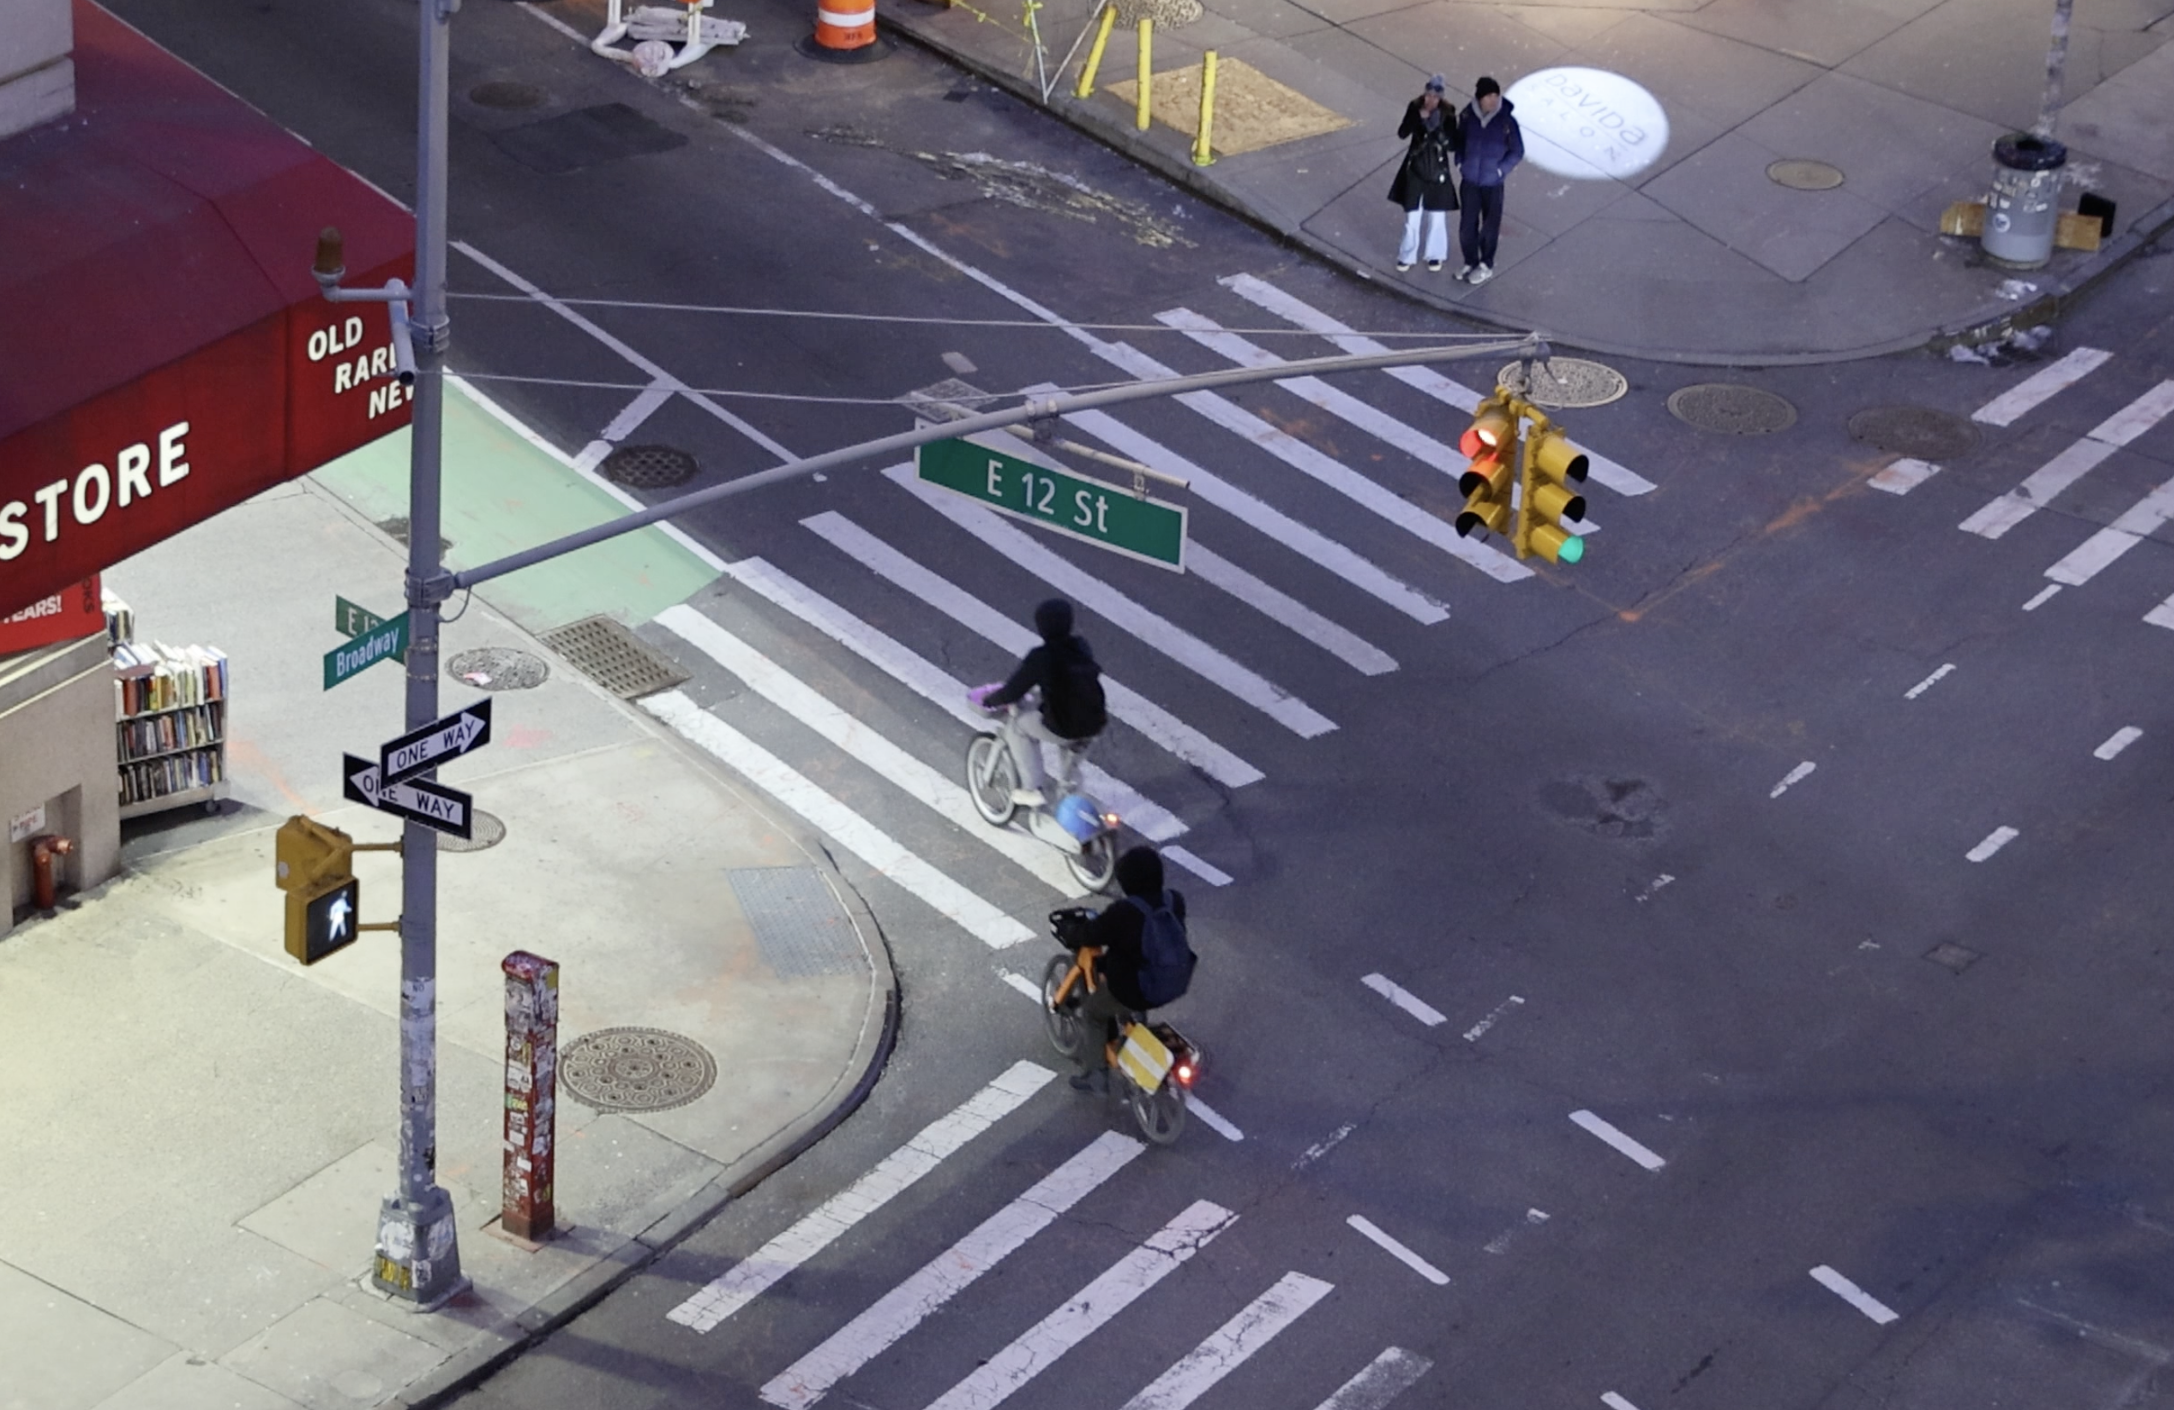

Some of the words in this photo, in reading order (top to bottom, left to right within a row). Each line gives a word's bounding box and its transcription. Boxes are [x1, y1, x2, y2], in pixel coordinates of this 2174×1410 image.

[308, 316, 363, 361] OLD
[0, 420, 190, 561] STORE
[986, 459, 1004, 497] E
[1021, 472, 1055, 515] 12
[1073, 490, 1109, 533] St
[4, 595, 62, 624] EARS!
[347, 606, 358, 636] E
[336, 627, 399, 678] Broadway
[396, 739, 429, 769] ONE
[444, 719, 475, 749] WAY
[416, 791, 455, 819] WAY
